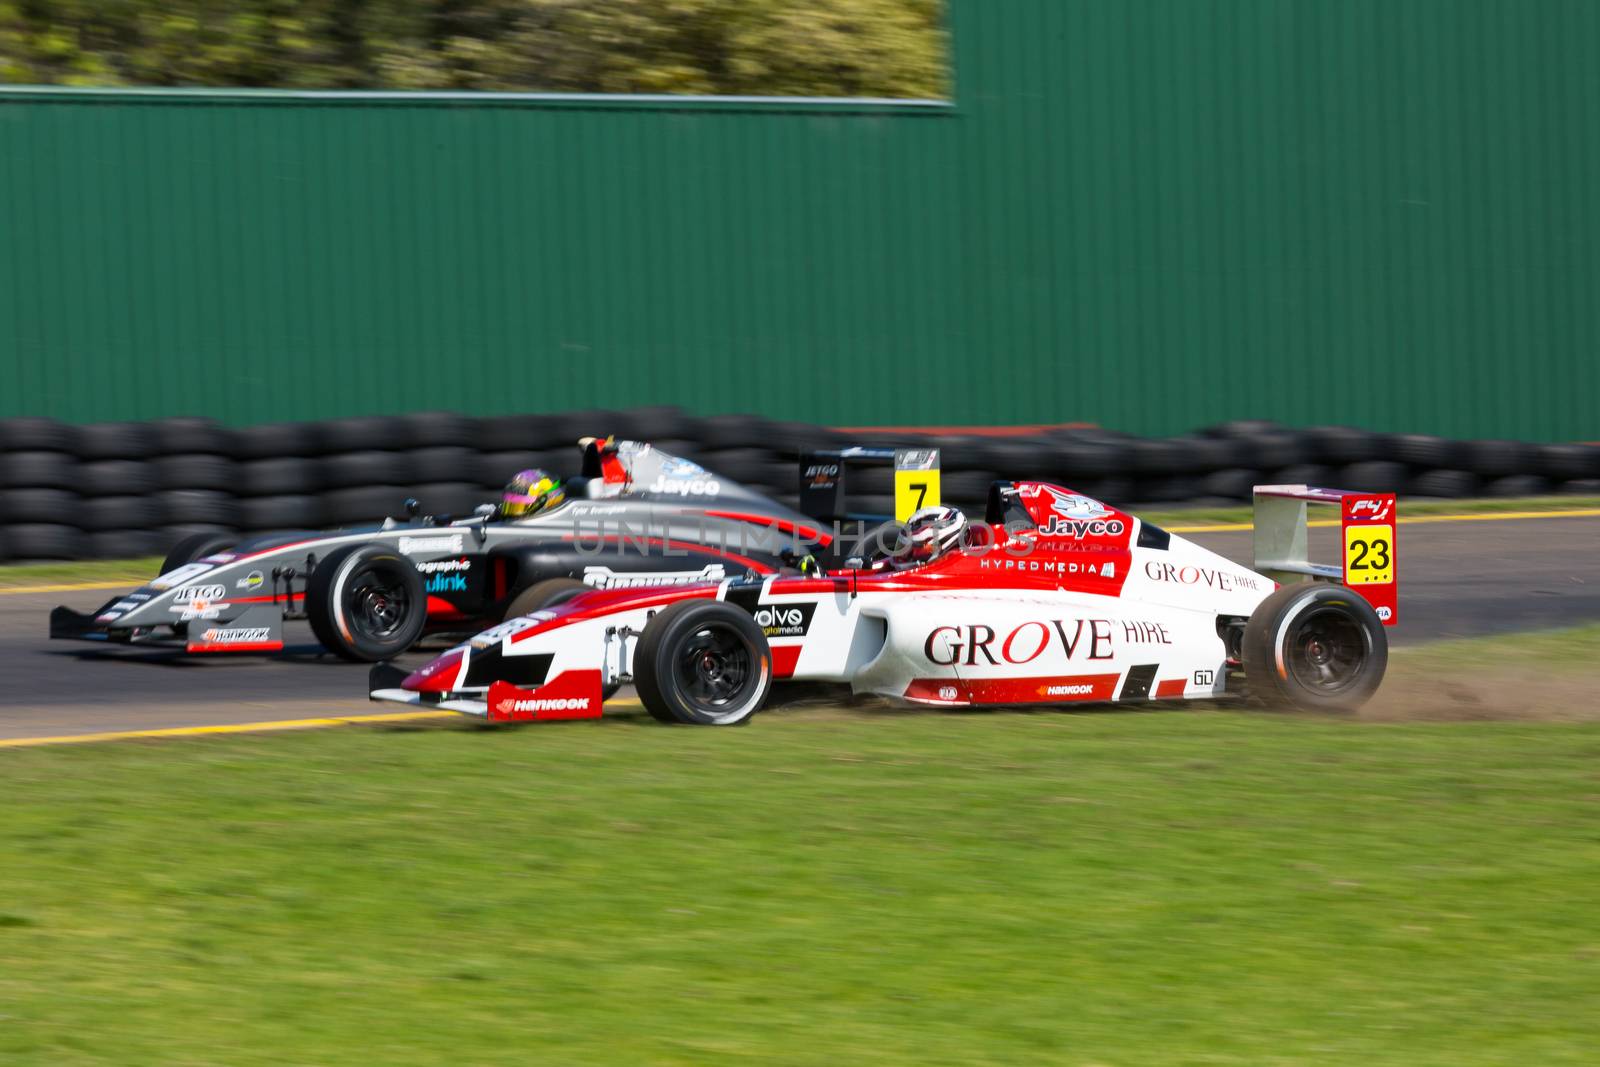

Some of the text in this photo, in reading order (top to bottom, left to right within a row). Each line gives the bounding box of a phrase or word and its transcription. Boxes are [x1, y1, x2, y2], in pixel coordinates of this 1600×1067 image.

[650, 475, 720, 496] Jayco
[909, 483, 927, 524] 7
[1039, 515, 1124, 539] Jayco
[1349, 539, 1390, 570] 23
[1145, 560, 1259, 592] GROVE HIRE
[176, 585, 225, 601] JETGO
[924, 619, 1173, 666] GROVE HIRE
